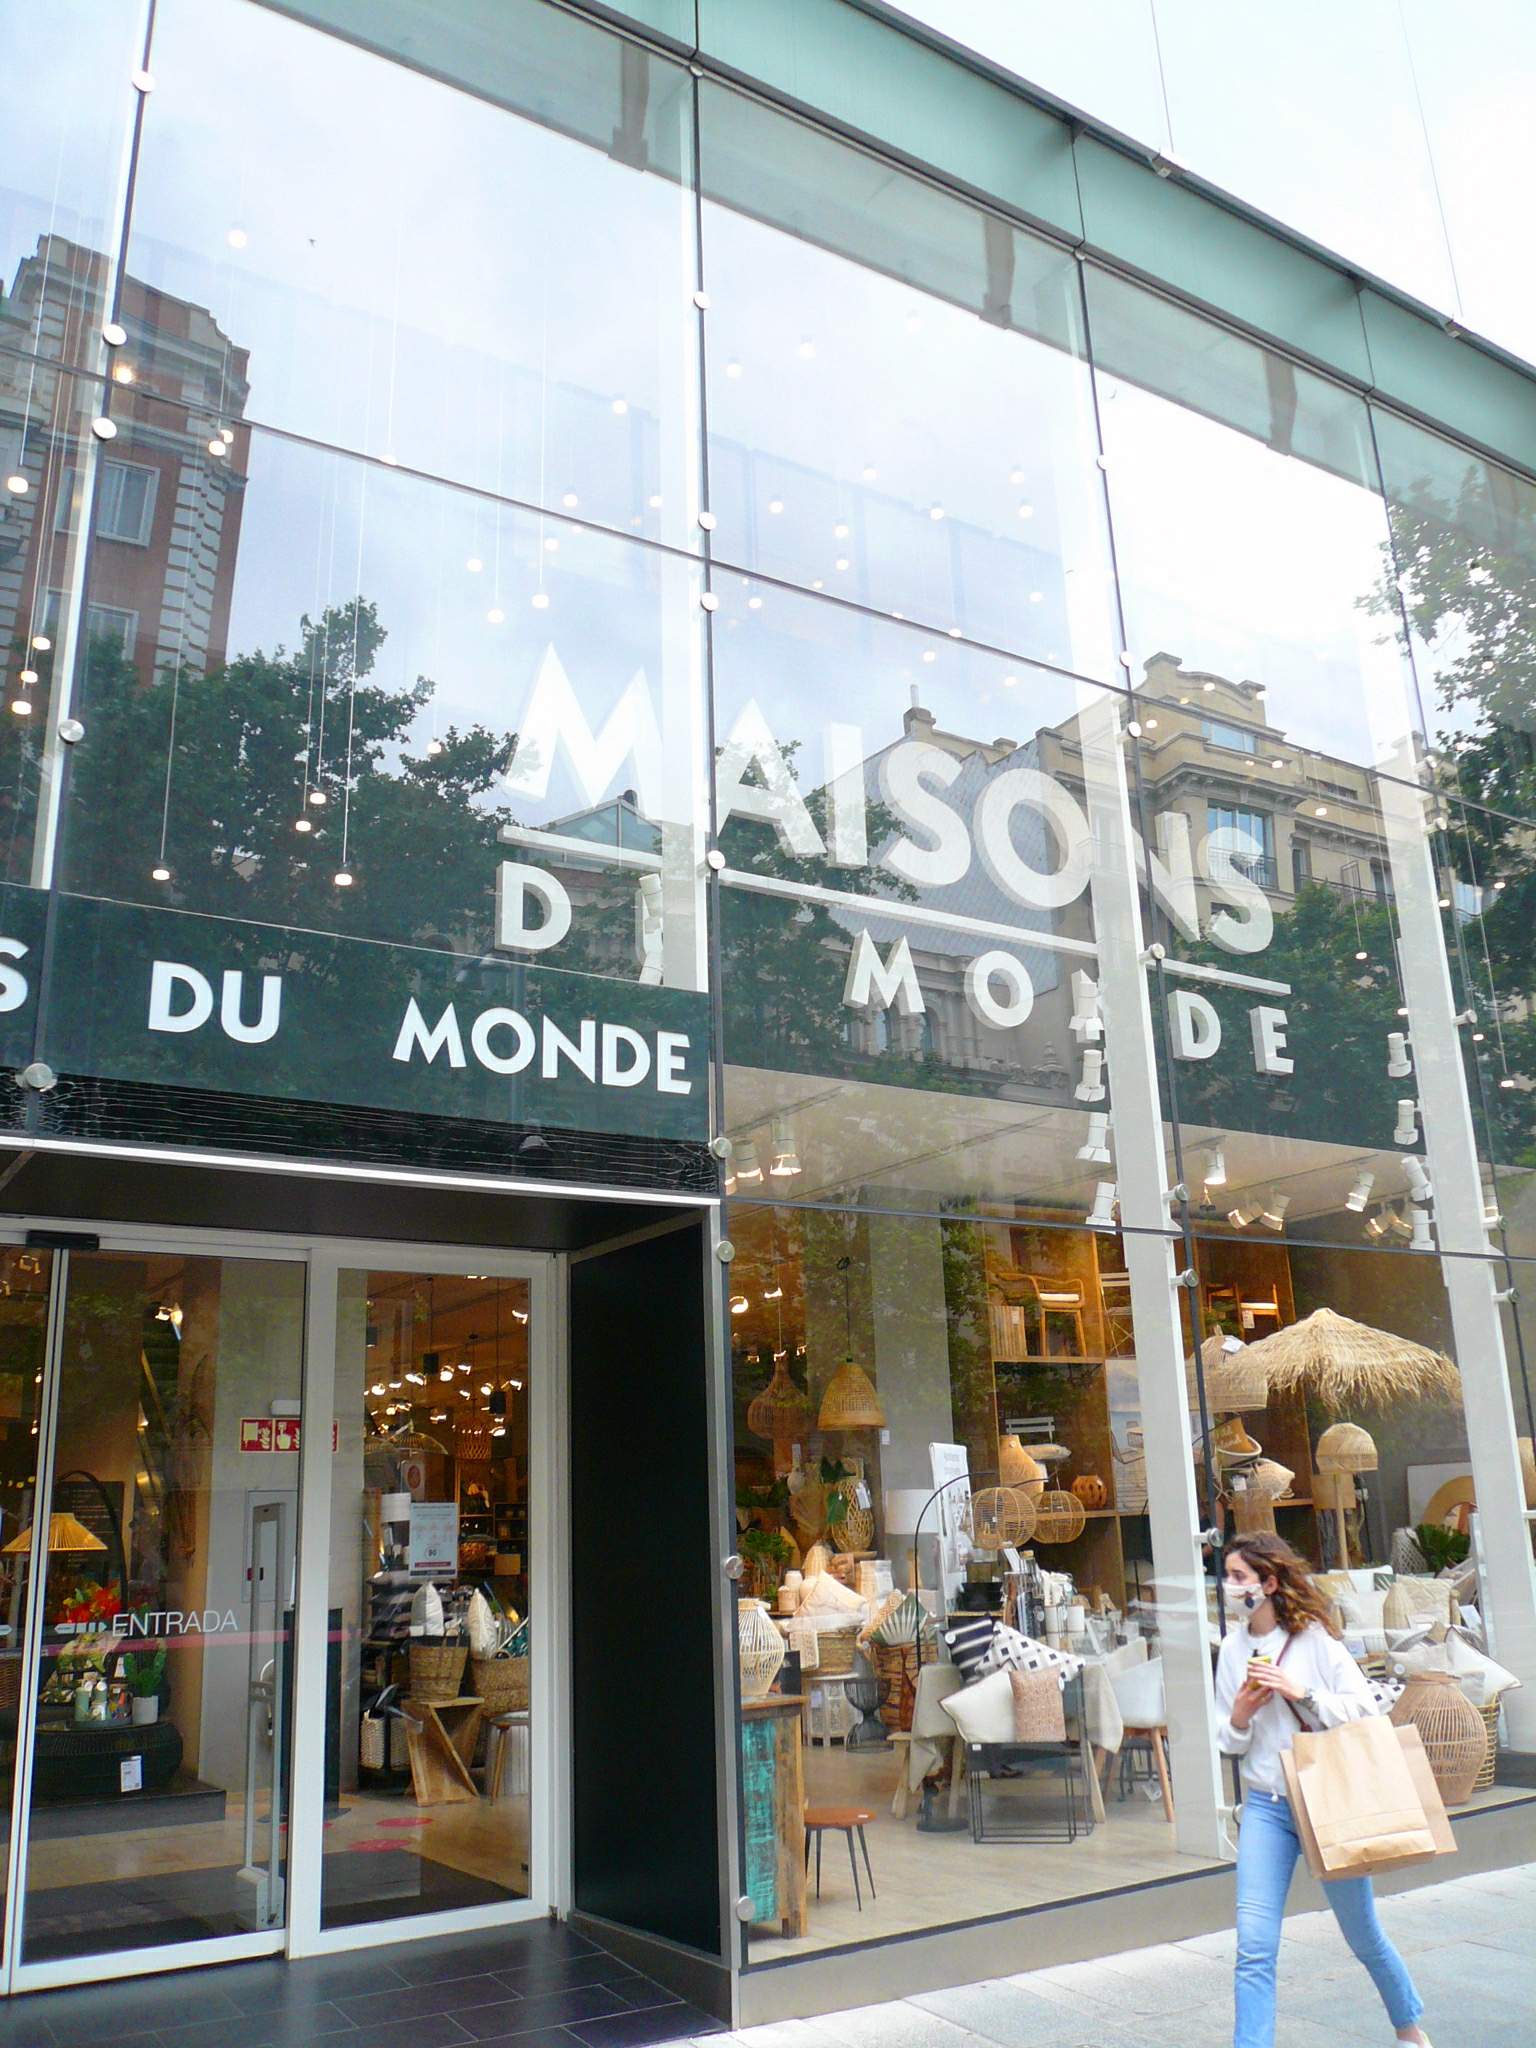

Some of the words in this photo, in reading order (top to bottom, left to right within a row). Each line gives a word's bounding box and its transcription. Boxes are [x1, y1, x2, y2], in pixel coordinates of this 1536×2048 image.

[148, 960, 282, 1043] DU
[392, 996, 692, 1095] MONDE
[112, 1609, 239, 1638] ENTRADA
